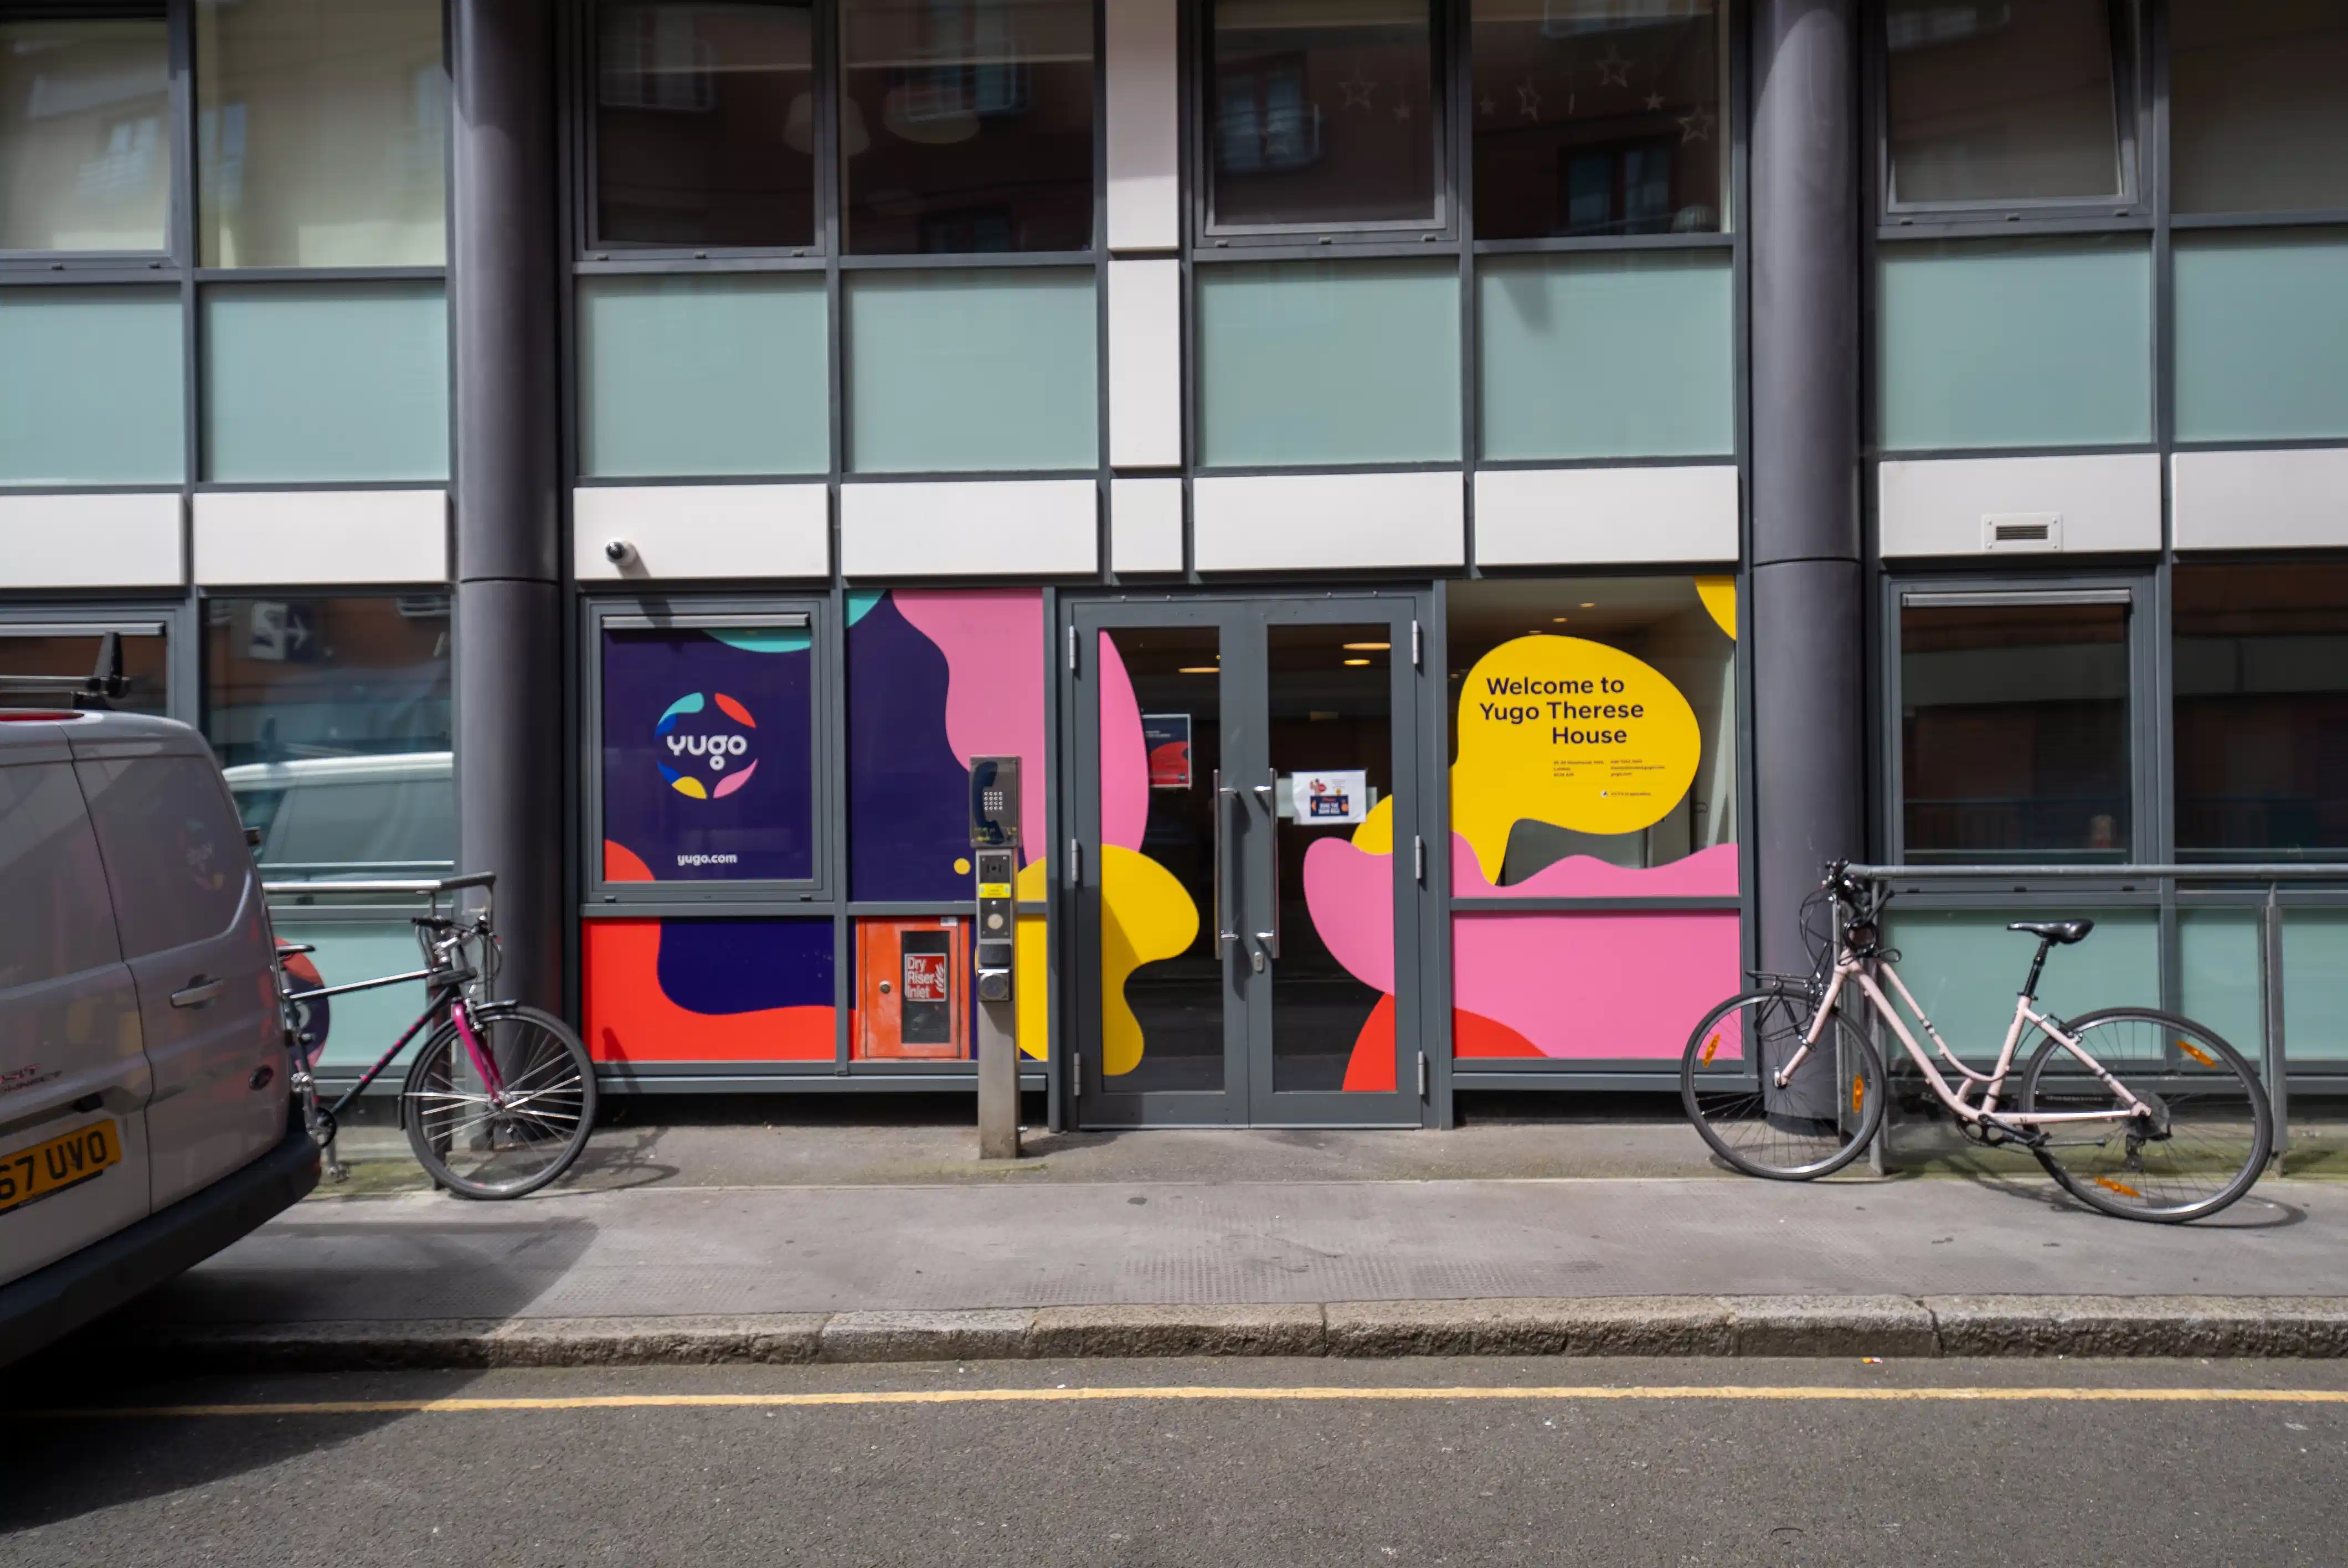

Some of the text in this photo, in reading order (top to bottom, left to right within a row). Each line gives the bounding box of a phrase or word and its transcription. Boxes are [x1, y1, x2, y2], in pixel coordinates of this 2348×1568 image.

[1486, 676, 1625, 695] Welcome to
[1479, 701, 1644, 725] Yugo Therese
[1552, 726, 1628, 744] House
[666, 735, 748, 770] yugo
[677, 854, 738, 866] yugo.com
[907, 957, 926, 973] Dry
[907, 971, 934, 984] Riser
[907, 984, 929, 998] Inlet
[45, 1130, 107, 1180] UVO
